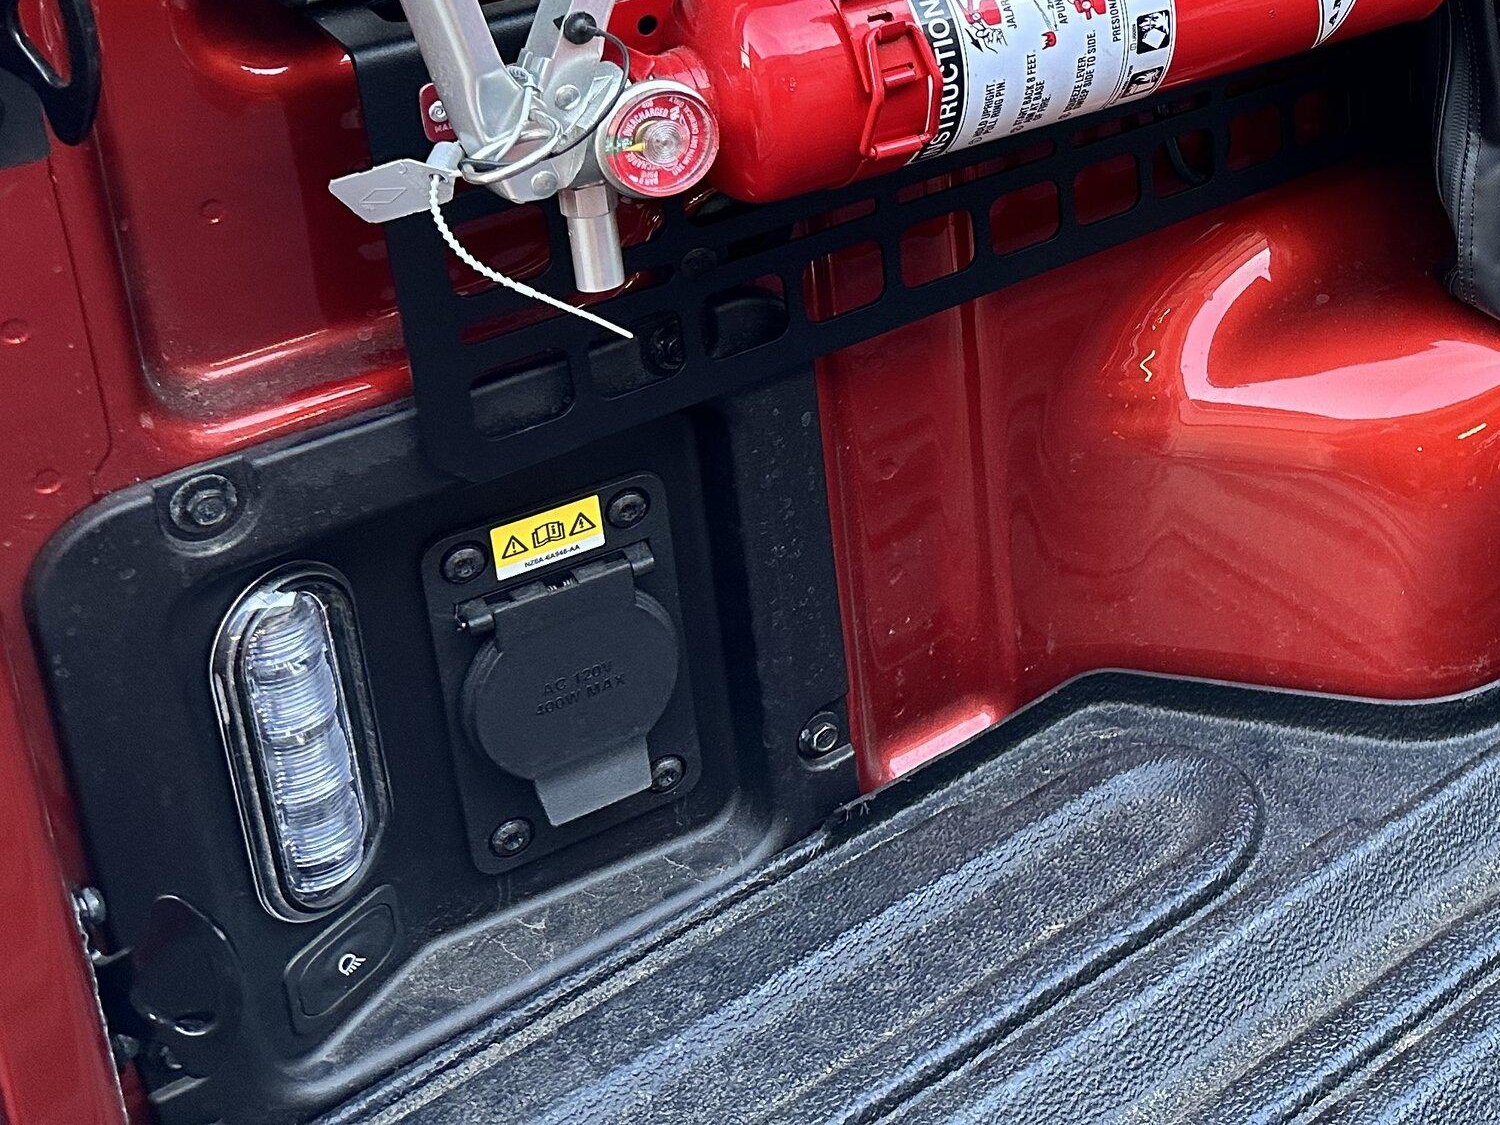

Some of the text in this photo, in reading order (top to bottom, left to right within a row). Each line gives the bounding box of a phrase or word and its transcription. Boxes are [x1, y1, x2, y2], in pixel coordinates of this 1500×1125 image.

[1001, 0, 1018, 29] JALAR
[1087, 56, 1096, 67] TO
[1083, 69, 1095, 88] SIDE
[1022, 84, 1034, 106] BACK
[1033, 80, 1045, 102] BASE
[544, 677, 567, 695] AC
[586, 673, 625, 698] MAX
